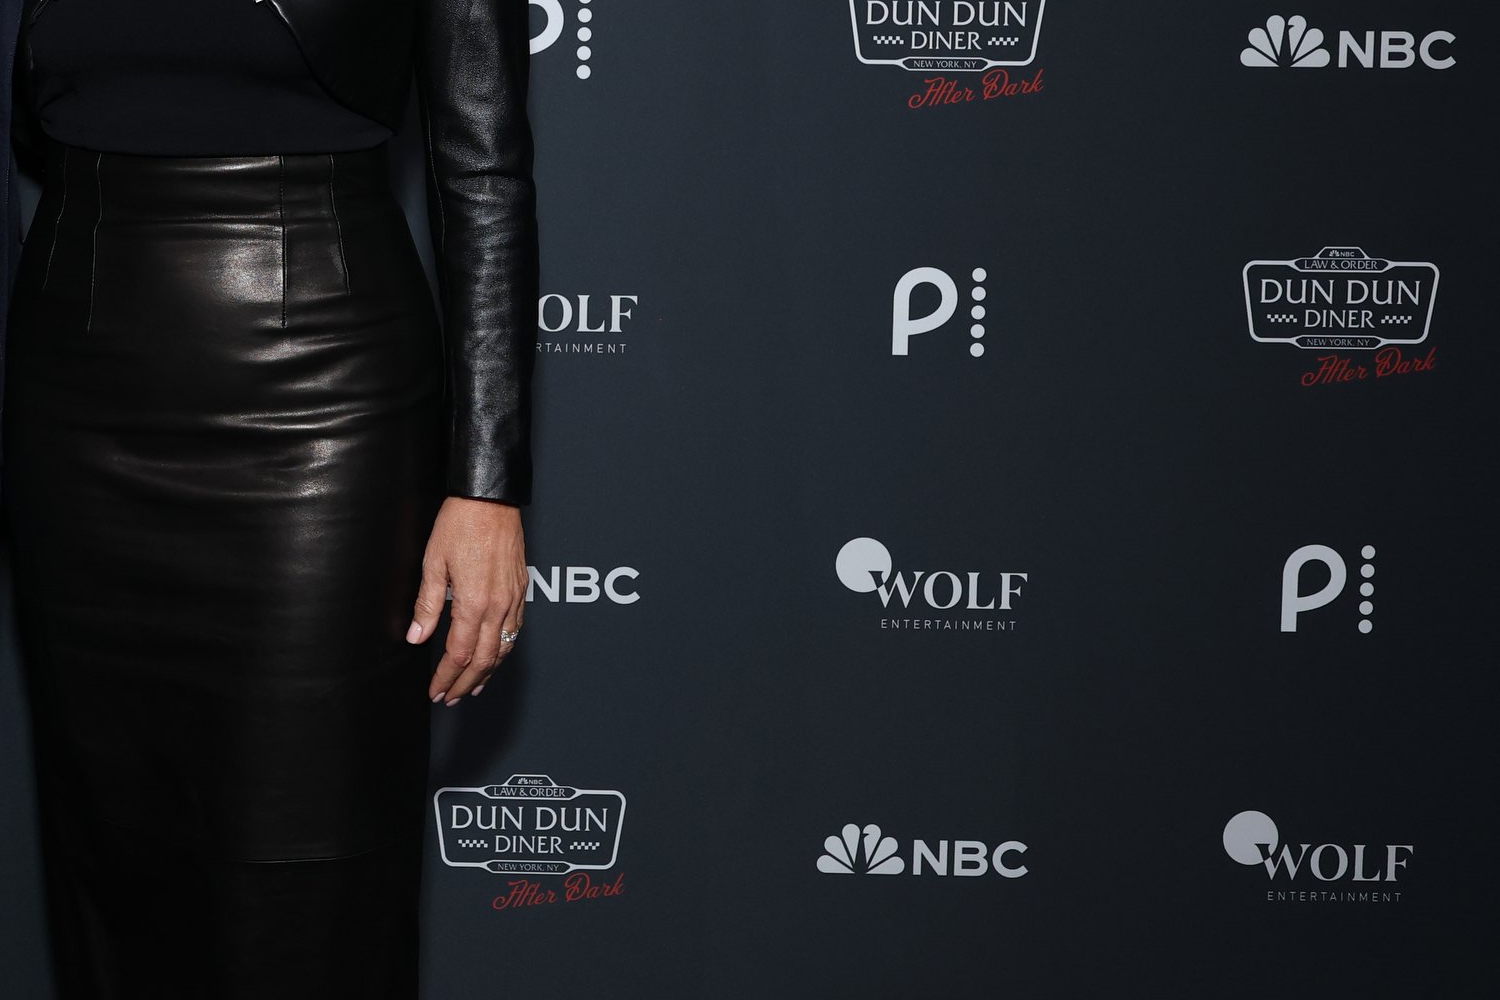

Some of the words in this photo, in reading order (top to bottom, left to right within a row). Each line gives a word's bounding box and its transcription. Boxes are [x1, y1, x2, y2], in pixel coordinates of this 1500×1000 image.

[866, 1, 940, 26] DUN
[953, 1, 1027, 27] DUN
[911, 31, 983, 50] DINER
[1339, 31, 1456, 69] NBC
[914, 60, 932, 68] NEW
[908, 76, 976, 109] After
[982, 68, 1044, 100] Dark
[1304, 260, 1328, 269] LAW
[1330, 260, 1340, 269] &
[1341, 261, 1378, 270] ORDER
[1260, 279, 1334, 305] DUN
[1347, 280, 1420, 305] DUN
[538, 294, 637, 332] OLF
[1304, 309, 1376, 328] DINER
[536, 343, 625, 353] RTAINMENT
[1307, 338, 1325, 346] NEW
[1301, 354, 1369, 387] After
[1375, 346, 1437, 378] Dark
[525, 566, 640, 604] NBC
[868, 572, 1027, 609] WOLF
[882, 619, 1015, 630] ENTERTAINMENT
[494, 788, 517, 796] LAW
[519, 788, 528, 796] &
[529, 788, 565, 797] ORDER
[451, 806, 523, 830] DUN
[536, 807, 608, 832] DUN
[495, 835, 565, 854] DINER
[913, 840, 1028, 878] NBC
[1255, 844, 1413, 881] WOLF
[493, 879, 559, 910] After
[564, 871, 625, 902] Dark
[1268, 891, 1400, 901] ENTERTAINMENT
